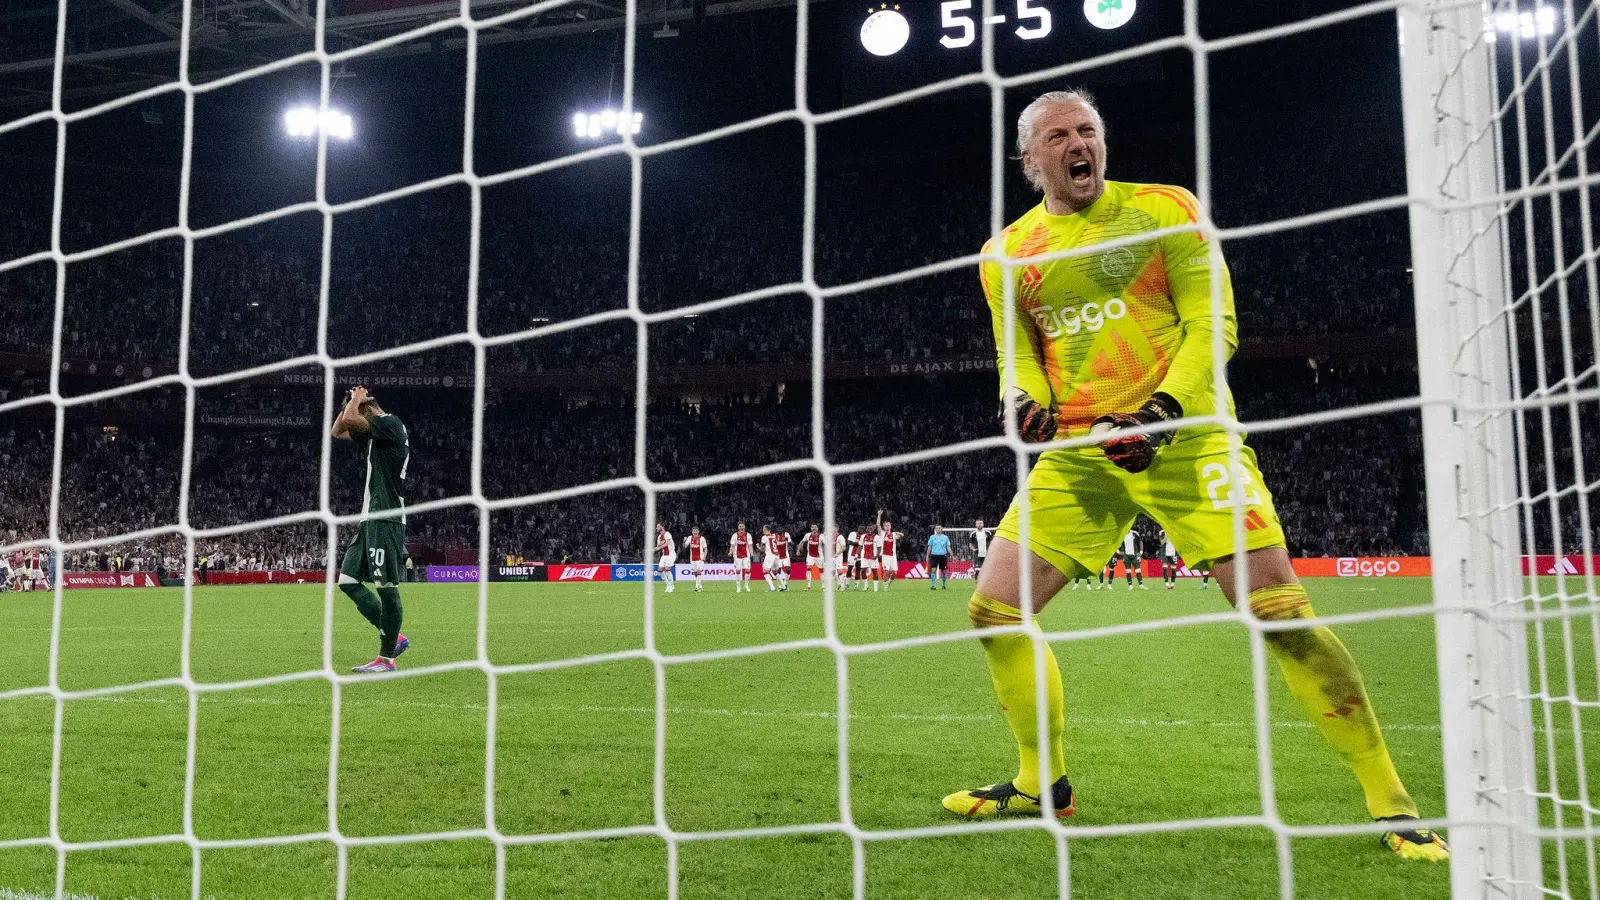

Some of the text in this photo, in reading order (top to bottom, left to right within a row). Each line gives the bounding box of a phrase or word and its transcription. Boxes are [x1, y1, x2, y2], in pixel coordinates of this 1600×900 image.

[1029, 298, 1127, 338] Ziggo
[890, 364, 908, 373] DE
[914, 361, 953, 373] AJAX
[284, 374, 440, 386] NEDERANDSE SUPERCUP
[201, 413, 312, 427] Champions Lounge AJAX
[499, 566, 535, 576] UNIBET
[565, 567, 592, 577] Bud
[1336, 557, 1401, 577] Ziggo
[433, 569, 478, 580] CURAÇAO
